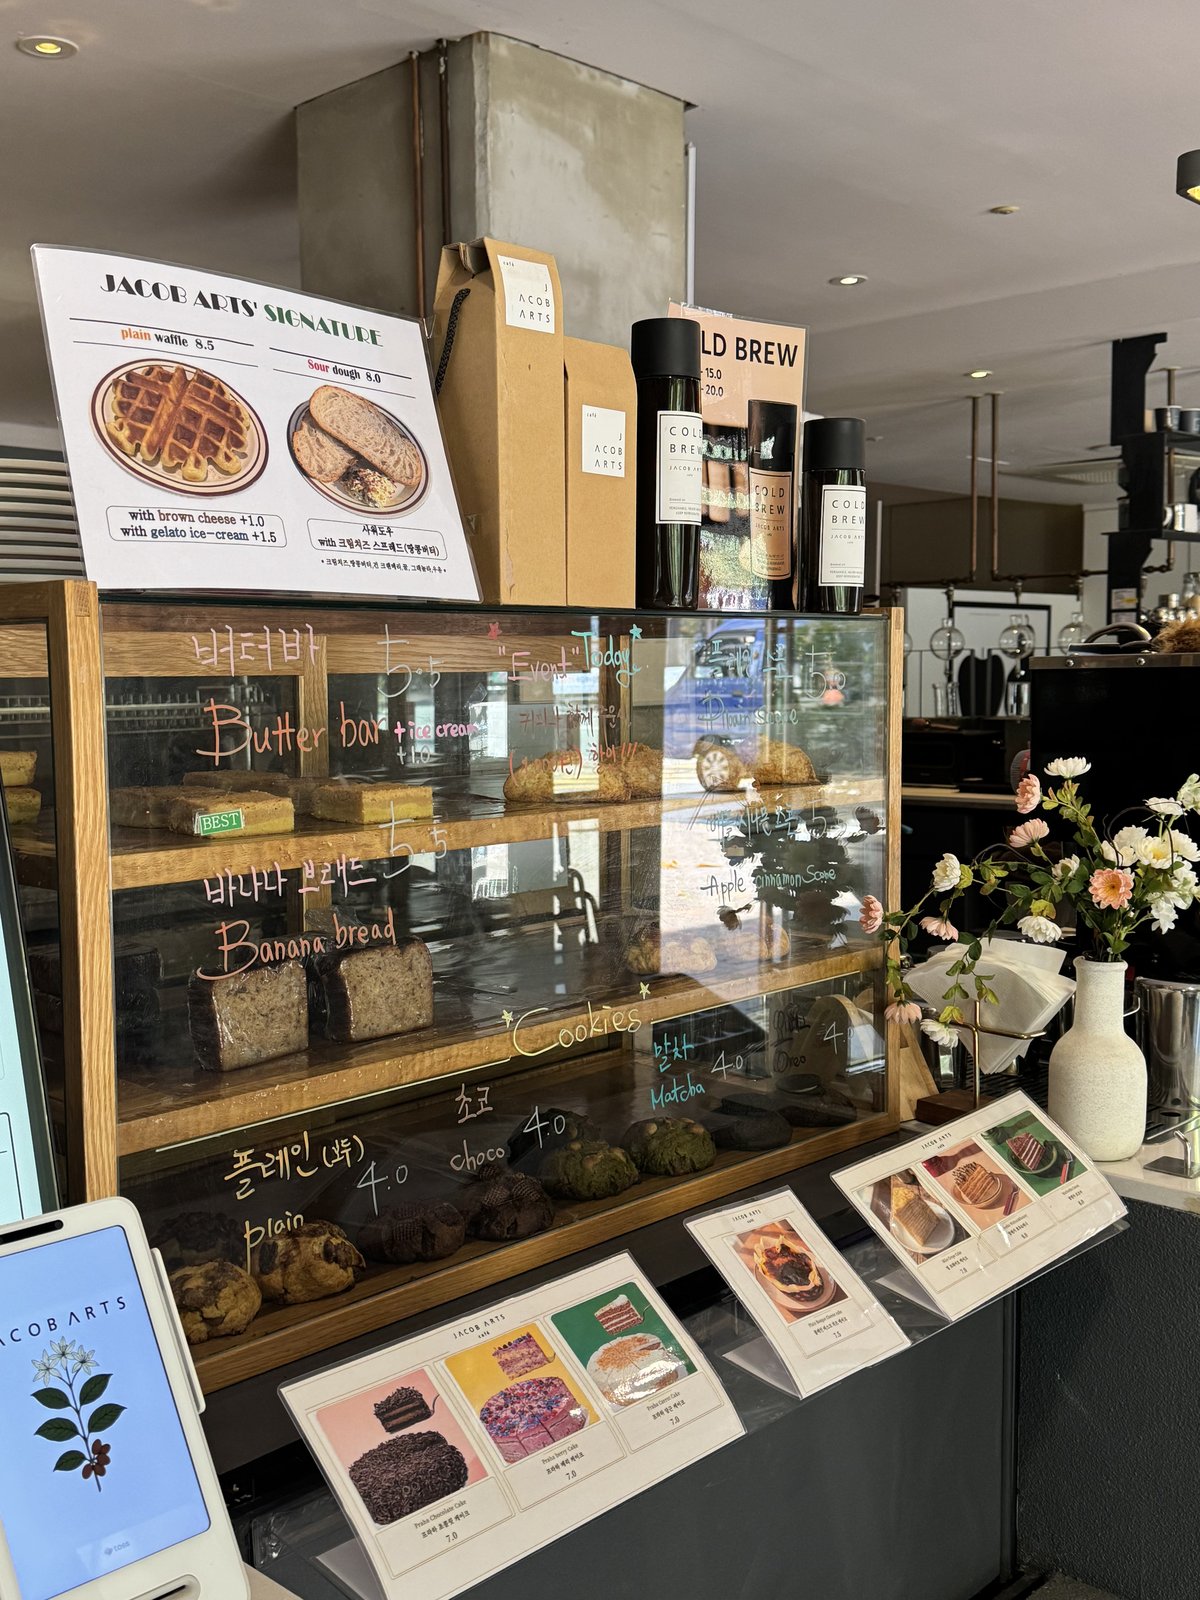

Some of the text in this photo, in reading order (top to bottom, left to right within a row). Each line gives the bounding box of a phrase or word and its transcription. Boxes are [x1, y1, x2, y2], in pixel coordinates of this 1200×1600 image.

[100, 274, 384, 347] JACOB ARTS' SIGNATURE
[520, 309, 550, 323] ARTS
[120, 327, 215, 351] plain waffle 8.5
[701, 330, 798, 367] LD BREW
[307, 359, 381, 384] Sour dough 8.0
[705, 367, 722, 380] 15.0
[706, 384, 724, 397] 20.0
[595, 459, 622, 470] ARTS
[755, 485, 785, 498] COLD
[832, 500, 864, 510] COLD
[128, 509, 265, 527] with brown cheese +1.0
[121, 525, 277, 543] with gelato ice-cream +1.5
[318, 537, 337, 547] with
[192, 623, 443, 698] 버터바 5.5
[196, 697, 326, 766] Butter
[340, 701, 388, 748] bar
[436, 723, 479, 738] cream
[397, 745, 430, 765] +1.0
[202, 812, 240, 831] BEST
[204, 861, 288, 907] 바나나
[700, 870, 746, 905] Apple
[197, 906, 397, 980] Banana bread
[514, 1001, 641, 1056] Cookies
[711, 1050, 744, 1080] 4.0
[455, 1083, 565, 1149] 초코 4.0
[450, 1139, 505, 1171] choco
[224, 1130, 319, 1200] 플레인
[356, 1160, 408, 1216] 4.0
[244, 1211, 304, 1274] plain
[69, 1296, 126, 1326] ARTS
[453, 1314, 505, 1339] JACOB ARTS
[565, 1469, 577, 1480] 7.0
[430, 1505, 454, 1521] Chocolate
[454, 1500, 467, 1509] Cake
[445, 1531, 458, 1542] 7.0
